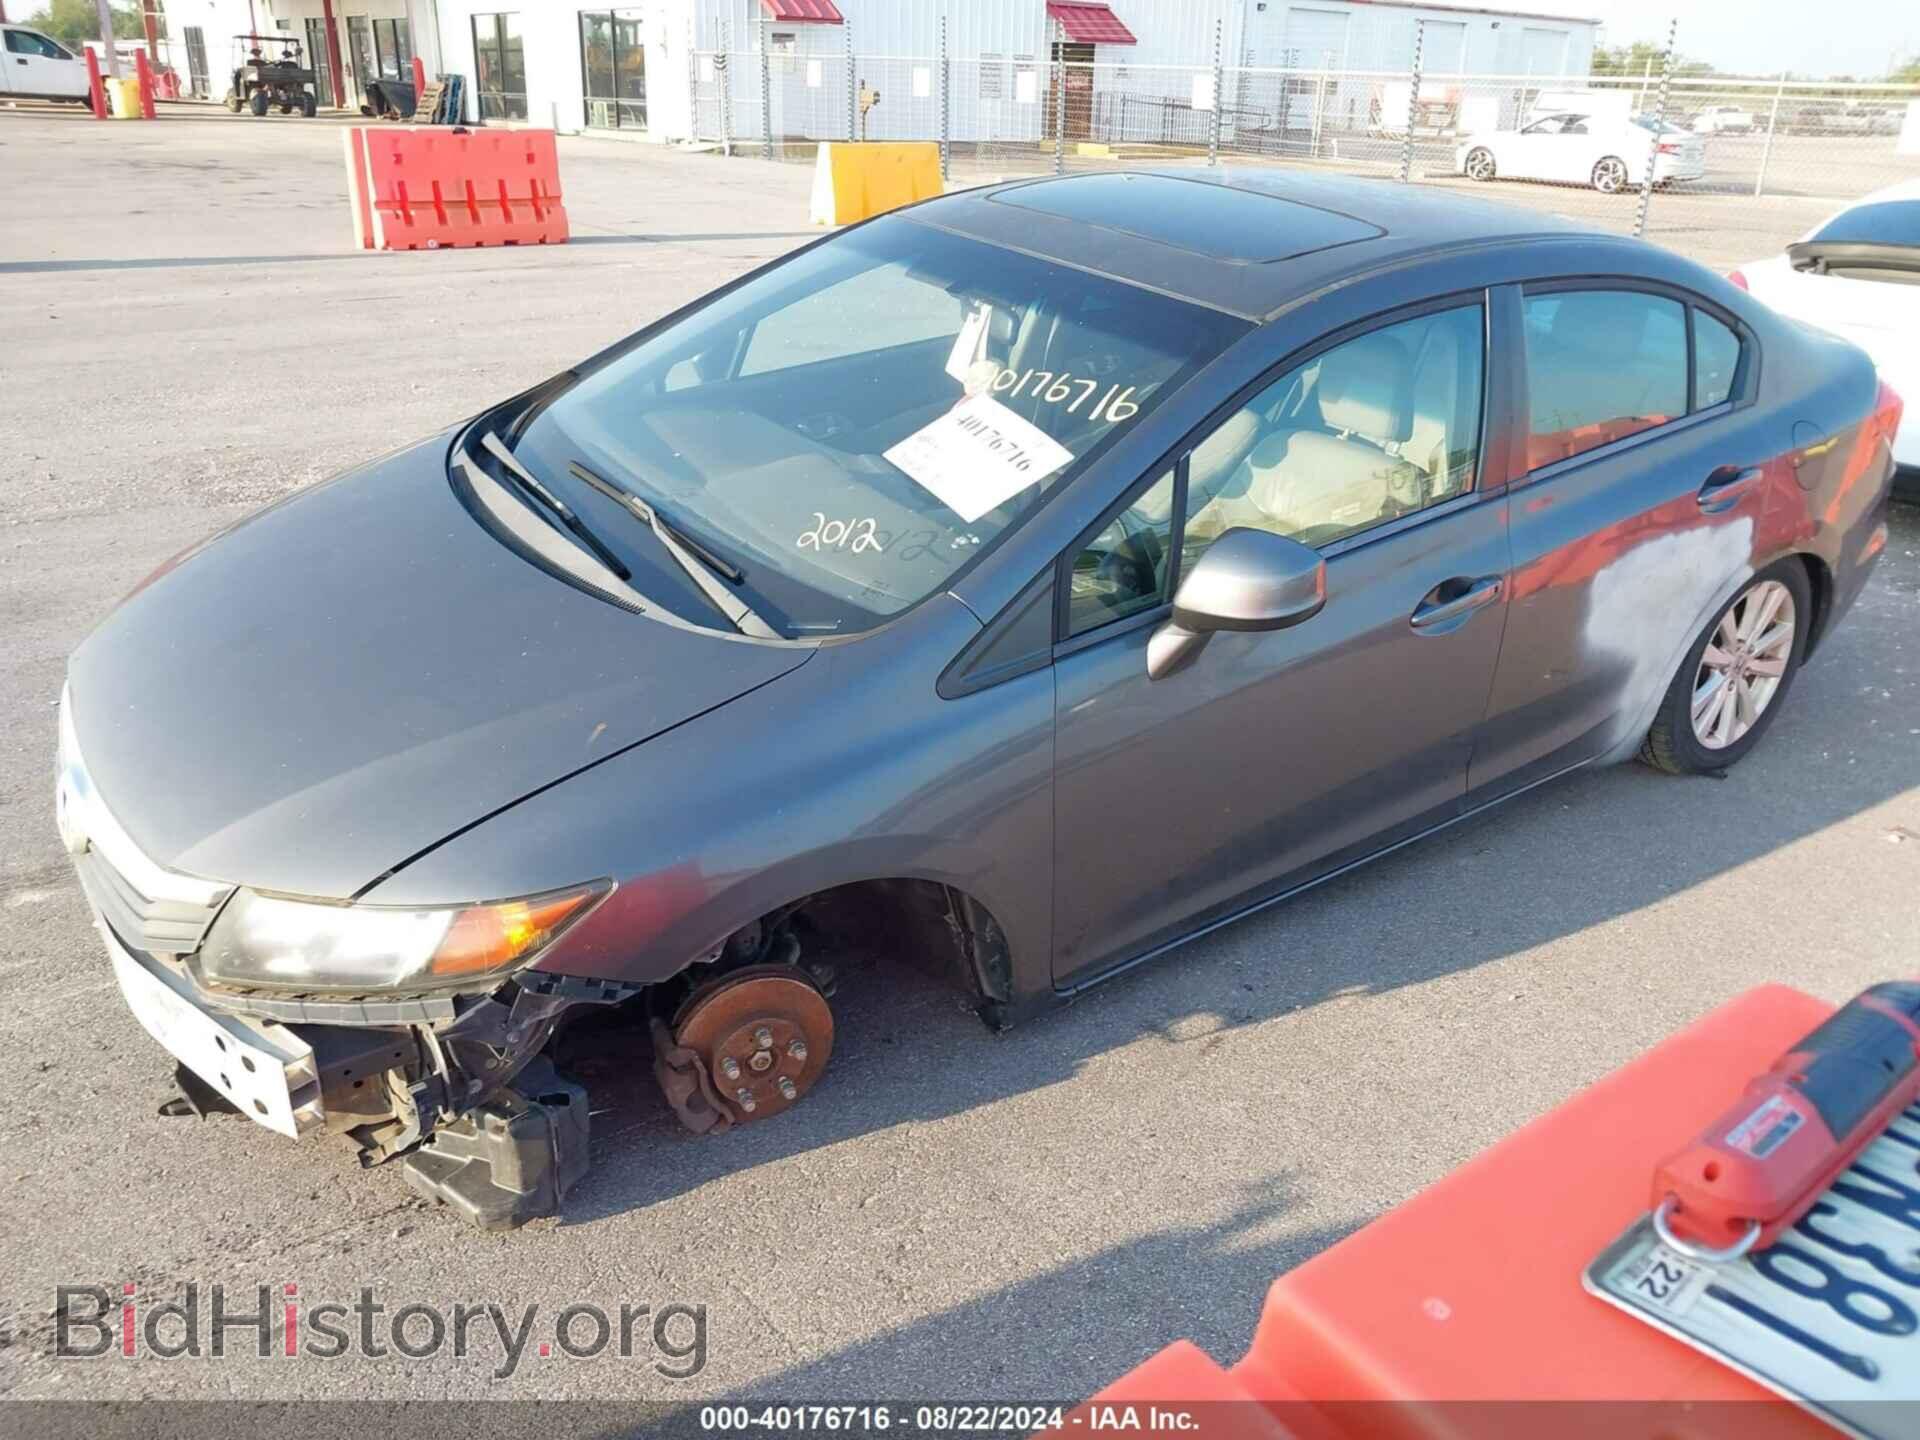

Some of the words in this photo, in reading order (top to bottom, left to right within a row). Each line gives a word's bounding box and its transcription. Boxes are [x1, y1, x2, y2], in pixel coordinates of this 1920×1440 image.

[957, 414, 1033, 472] 40176716
[796, 512, 883, 553] 2012
[1637, 1261, 1683, 1298] 22
